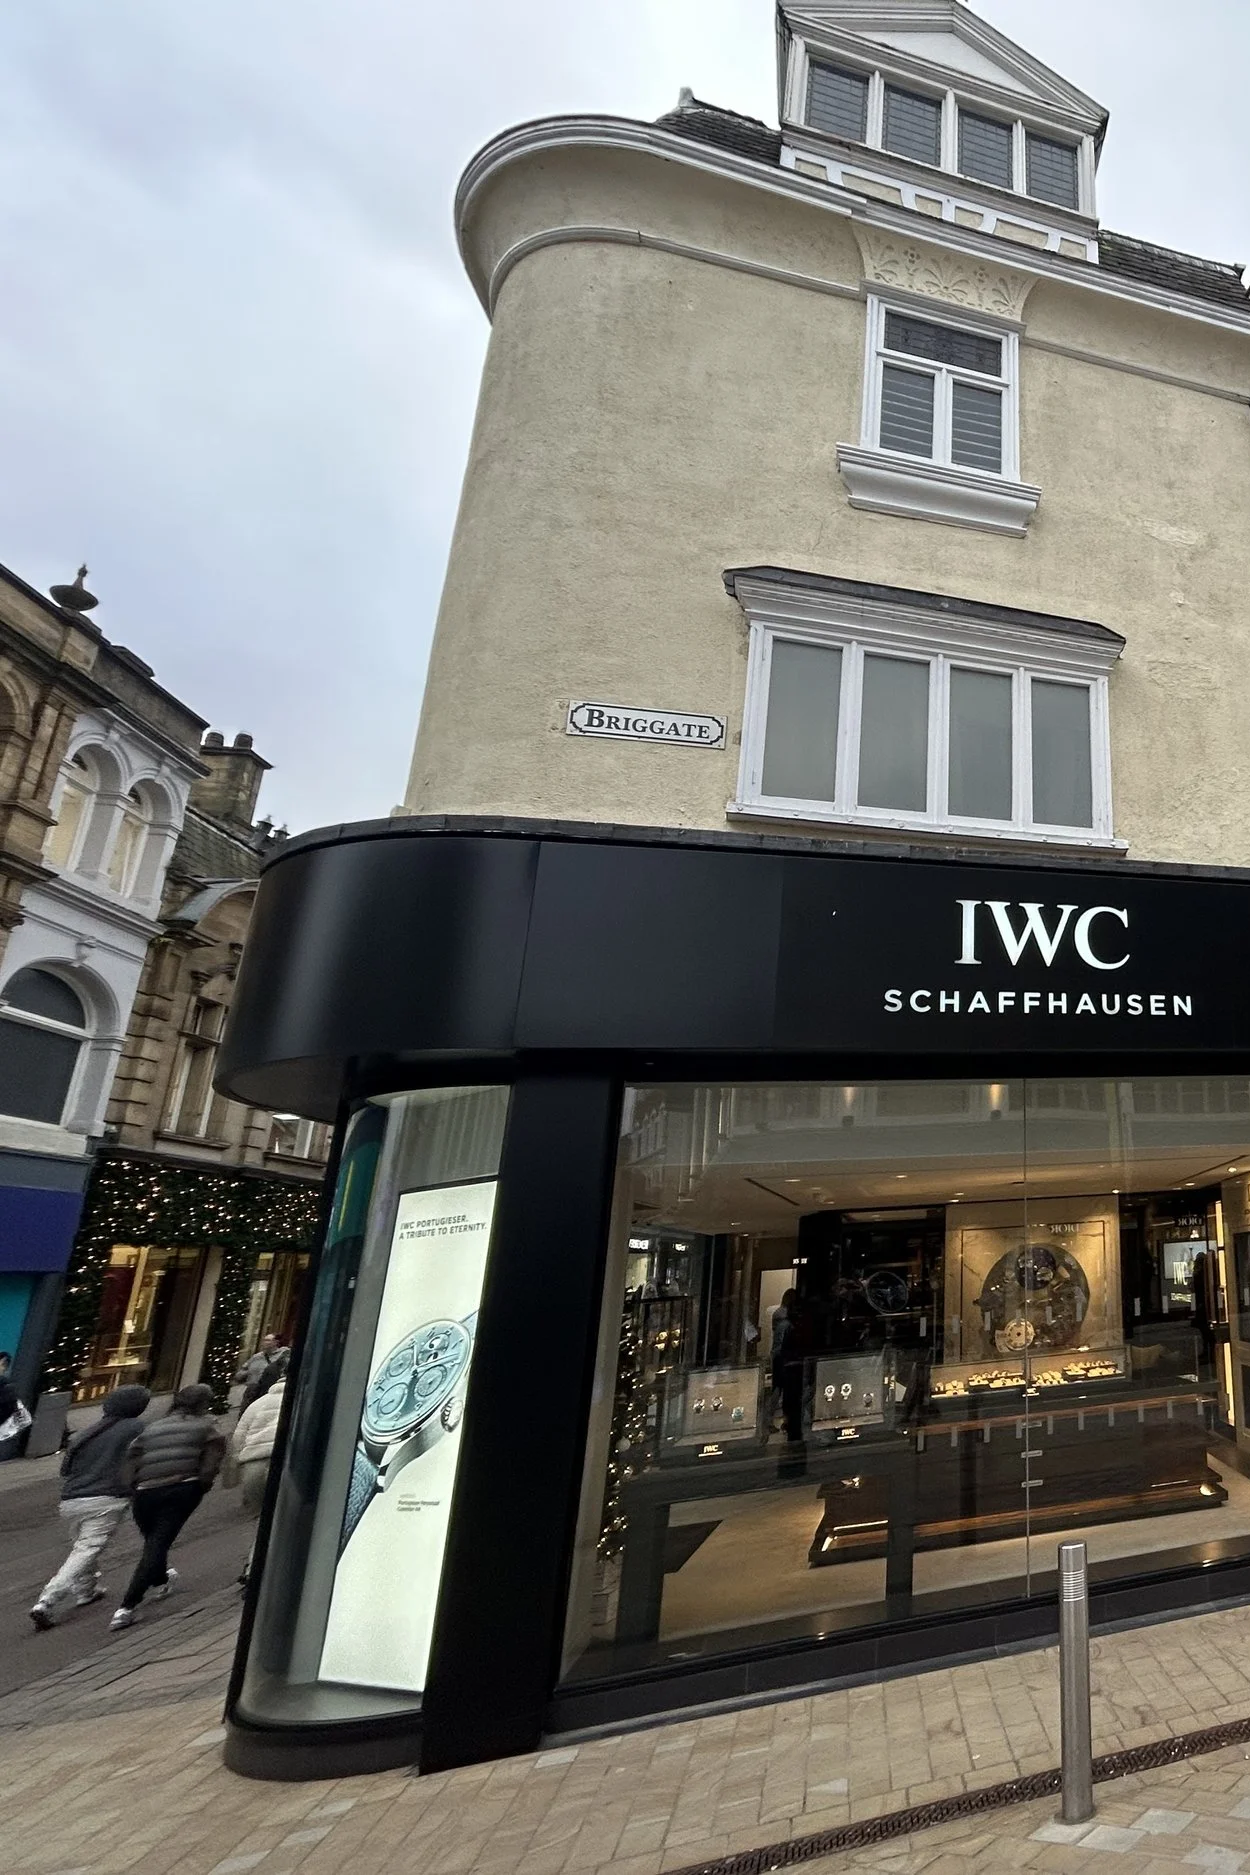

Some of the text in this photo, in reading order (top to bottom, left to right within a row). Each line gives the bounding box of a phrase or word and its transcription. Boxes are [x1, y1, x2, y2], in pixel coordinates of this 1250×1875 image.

[584, 708, 711, 739] BRIGGATE
[954, 899, 1130, 970] IWC
[883, 988, 1193, 1017] SCHAFFHAUSEN
[399, 1232, 404, 1240] A
[406, 1228, 436, 1239] TRIBUTE
[438, 1226, 448, 1235] TO
[400, 1214, 469, 1230] IWC PORTUGIESER.
